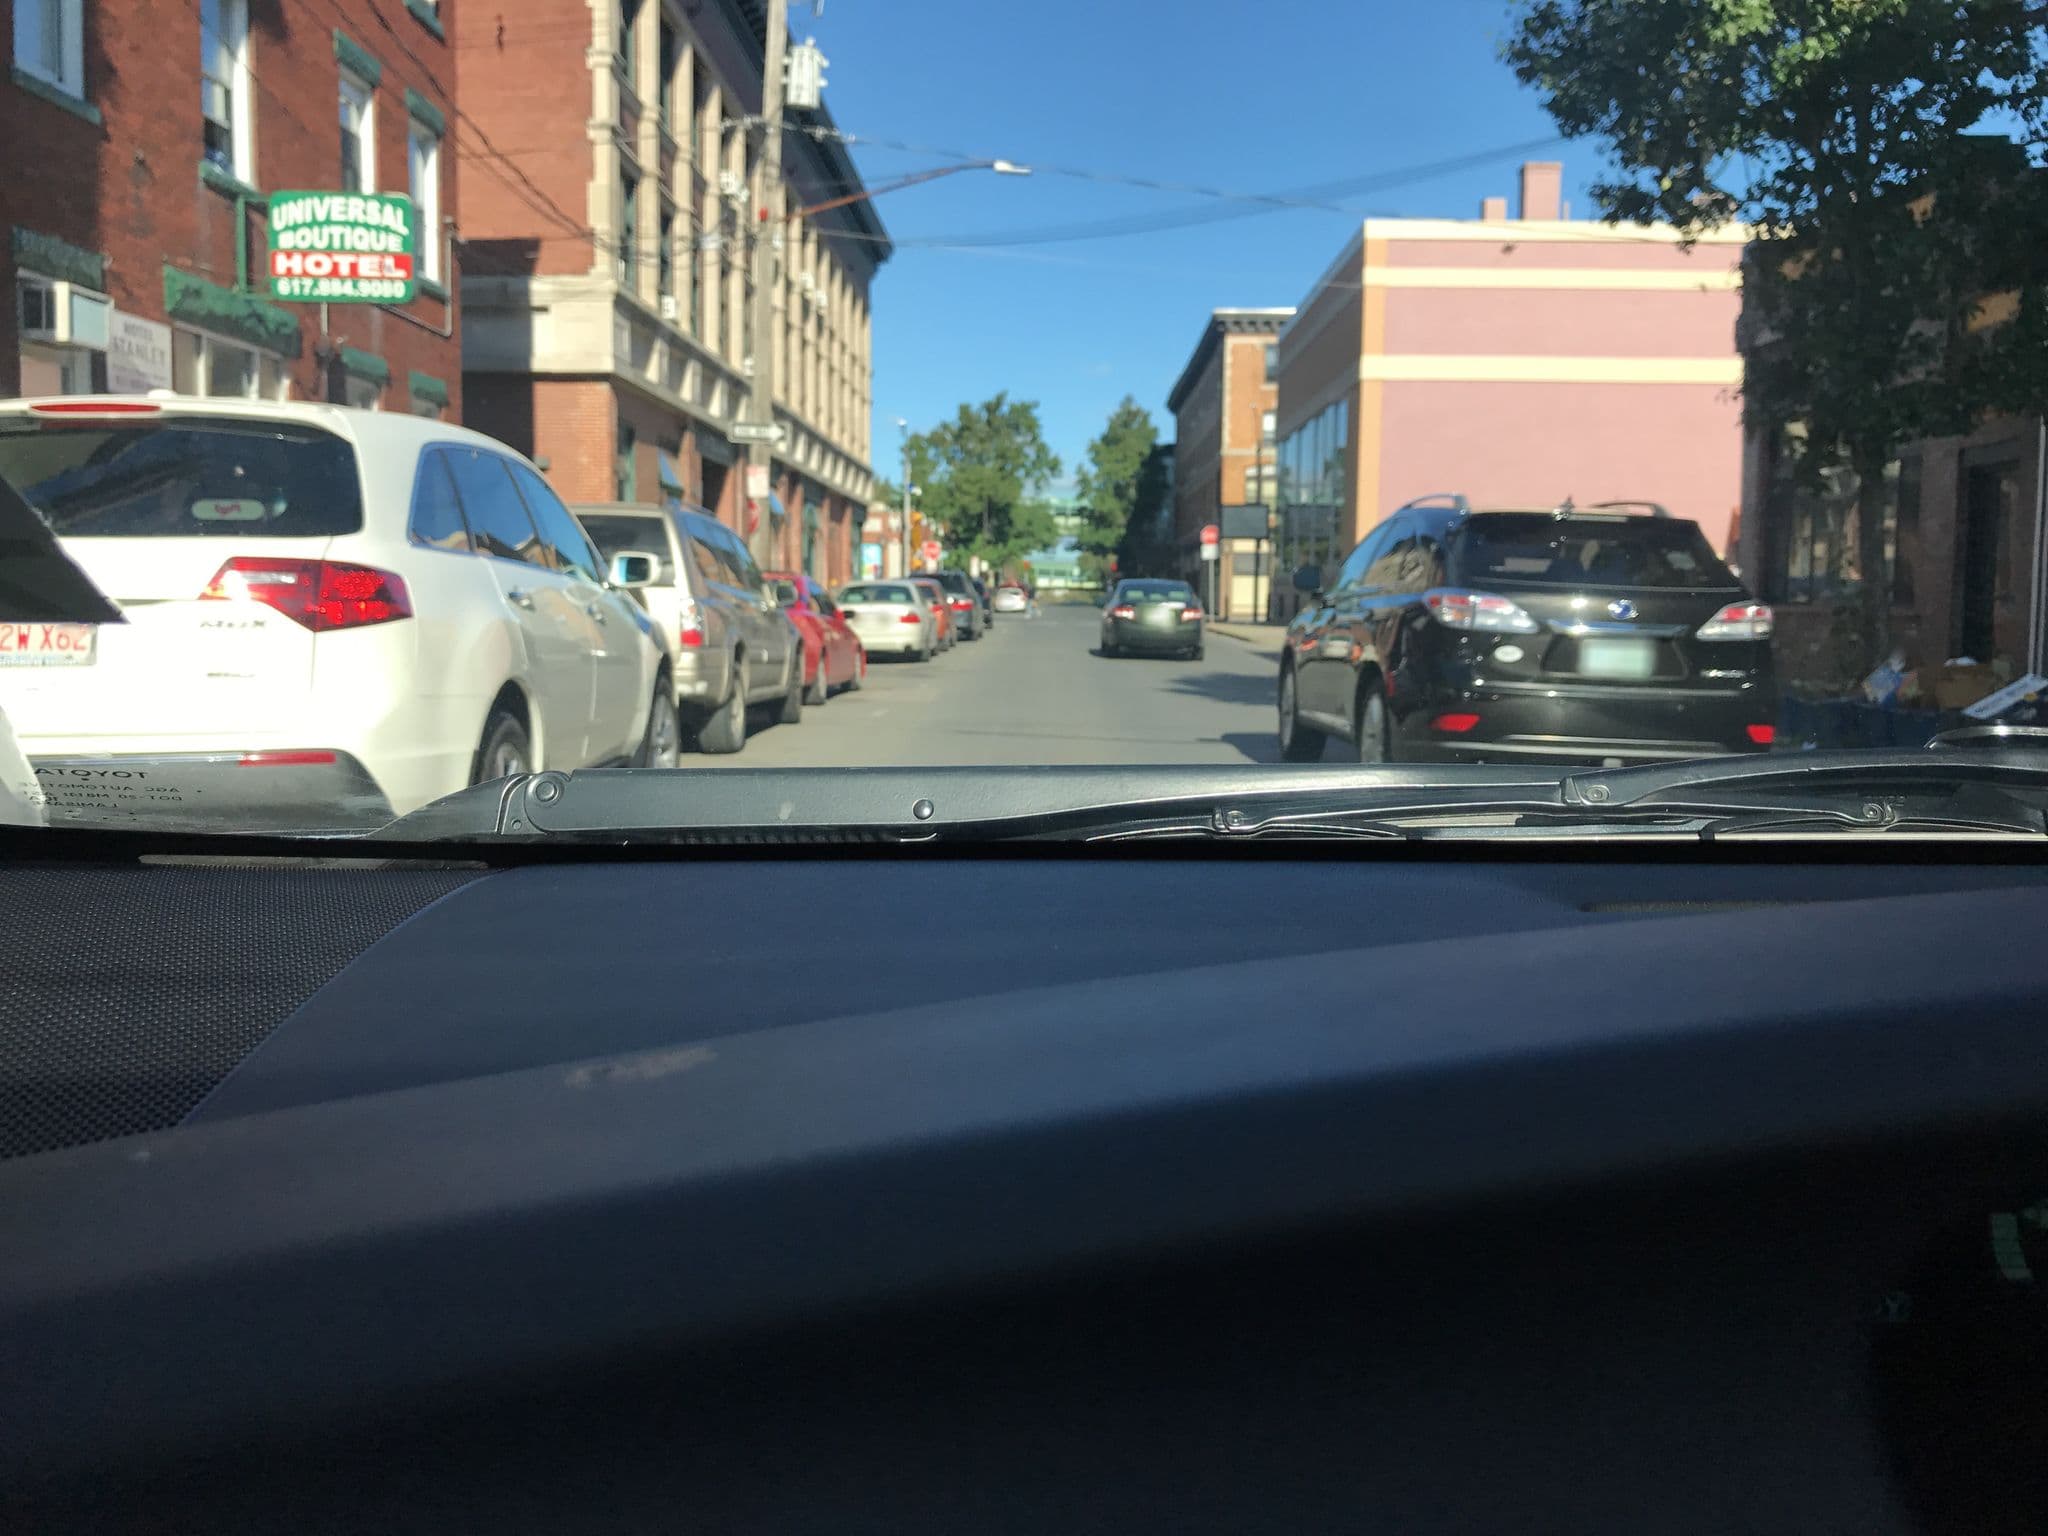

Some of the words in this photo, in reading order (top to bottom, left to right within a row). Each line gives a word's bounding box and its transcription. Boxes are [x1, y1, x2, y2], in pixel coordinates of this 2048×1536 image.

[272, 196, 409, 236] UNIVERSAL
[278, 224, 404, 252] BOUTIQUE
[275, 253, 408, 278] HOTEL
